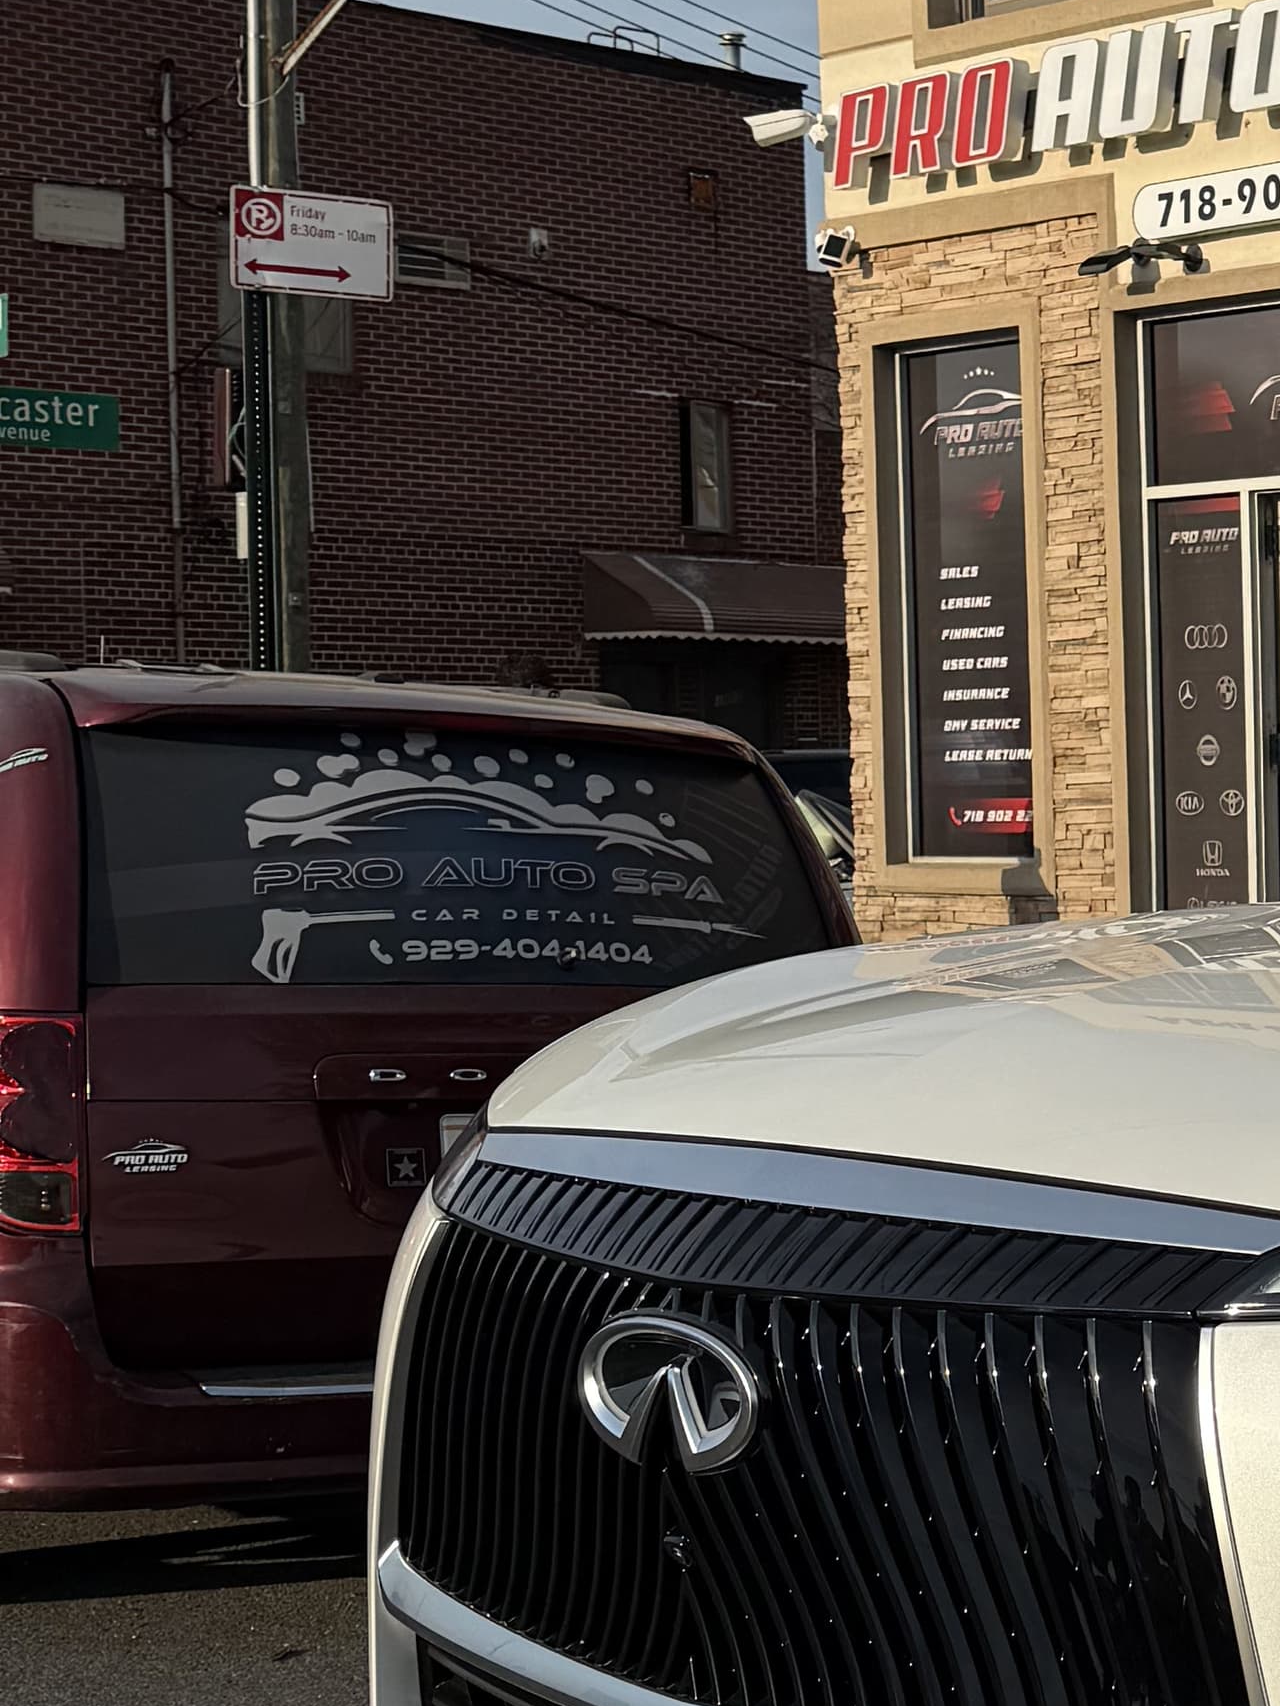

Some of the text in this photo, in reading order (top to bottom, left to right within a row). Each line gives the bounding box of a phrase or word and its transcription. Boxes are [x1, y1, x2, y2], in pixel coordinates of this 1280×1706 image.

[834, 58, 1022, 190] PRO
[290, 205, 326, 222] Friday
[290, 223, 335, 240] 8:30am
[347, 229, 376, 244] 10am
[934, 423, 974, 445] PRO
[1170, 527, 1239, 545] PRO AUTO
[939, 565, 979, 580] SALES
[940, 595, 992, 610] LEASING
[941, 625, 1005, 640] FINANCING
[942, 656, 1008, 671] USED CARS
[943, 687, 1010, 701] INSURANCE
[943, 718, 1021, 732] DMV SERVICE
[944, 749, 1033, 762] LEASE RETURN
[963, 809, 984, 822] 718
[986, 809, 1013, 822] 902
[252, 856, 724, 904] PRO AUTO SPA
[1196, 868, 1230, 877] HONDA
[411, 909, 615, 925] CAR DETAIL
[113, 1153, 188, 1165] PRO AUTO
[124, 1164, 177, 1172] LEASING
